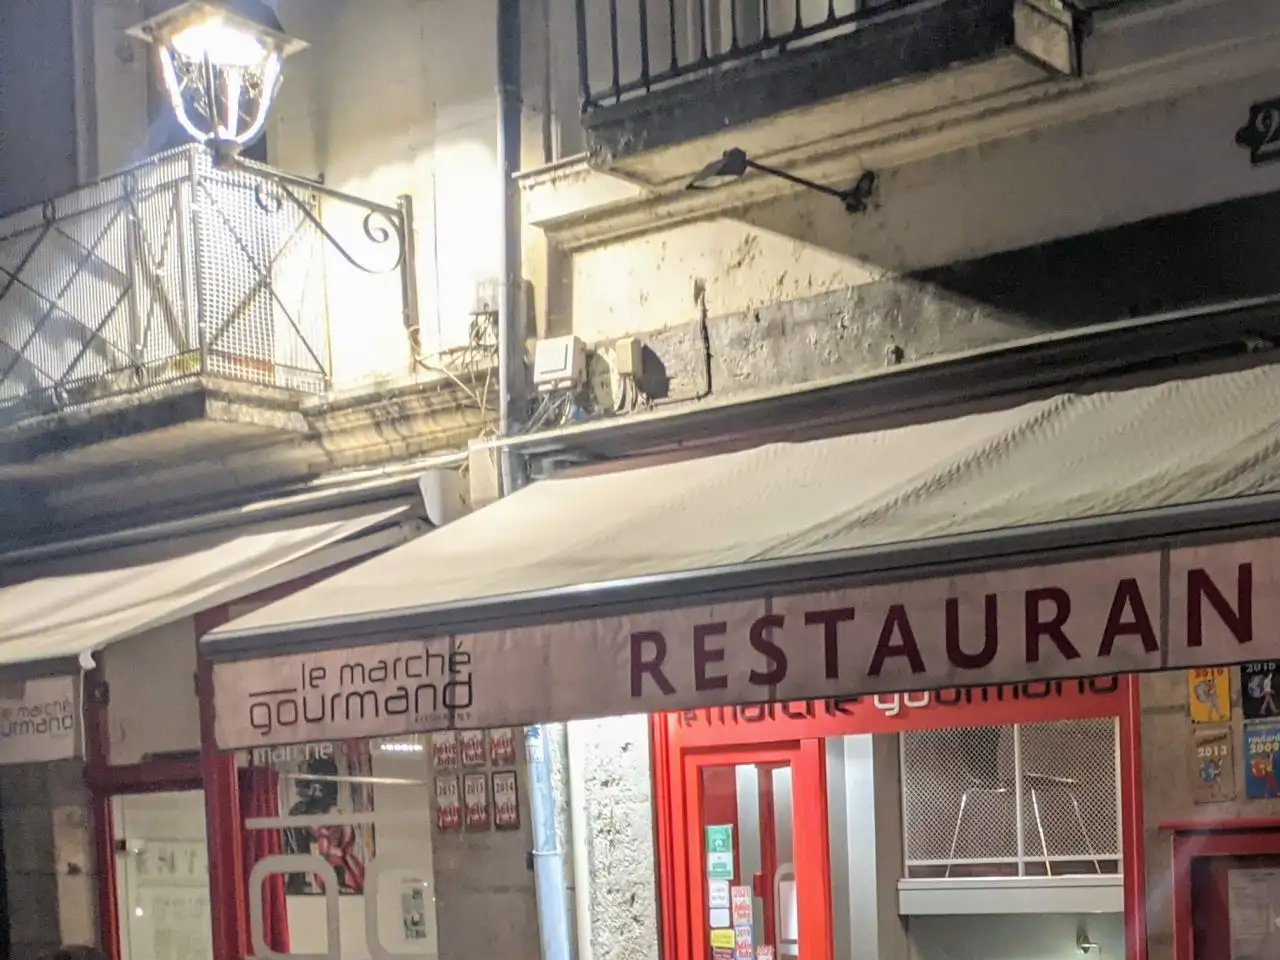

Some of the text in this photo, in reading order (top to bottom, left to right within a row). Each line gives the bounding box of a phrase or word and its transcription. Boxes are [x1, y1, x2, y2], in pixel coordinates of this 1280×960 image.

[301, 640, 471, 690] le marché
[249, 672, 473, 736] gourmand
